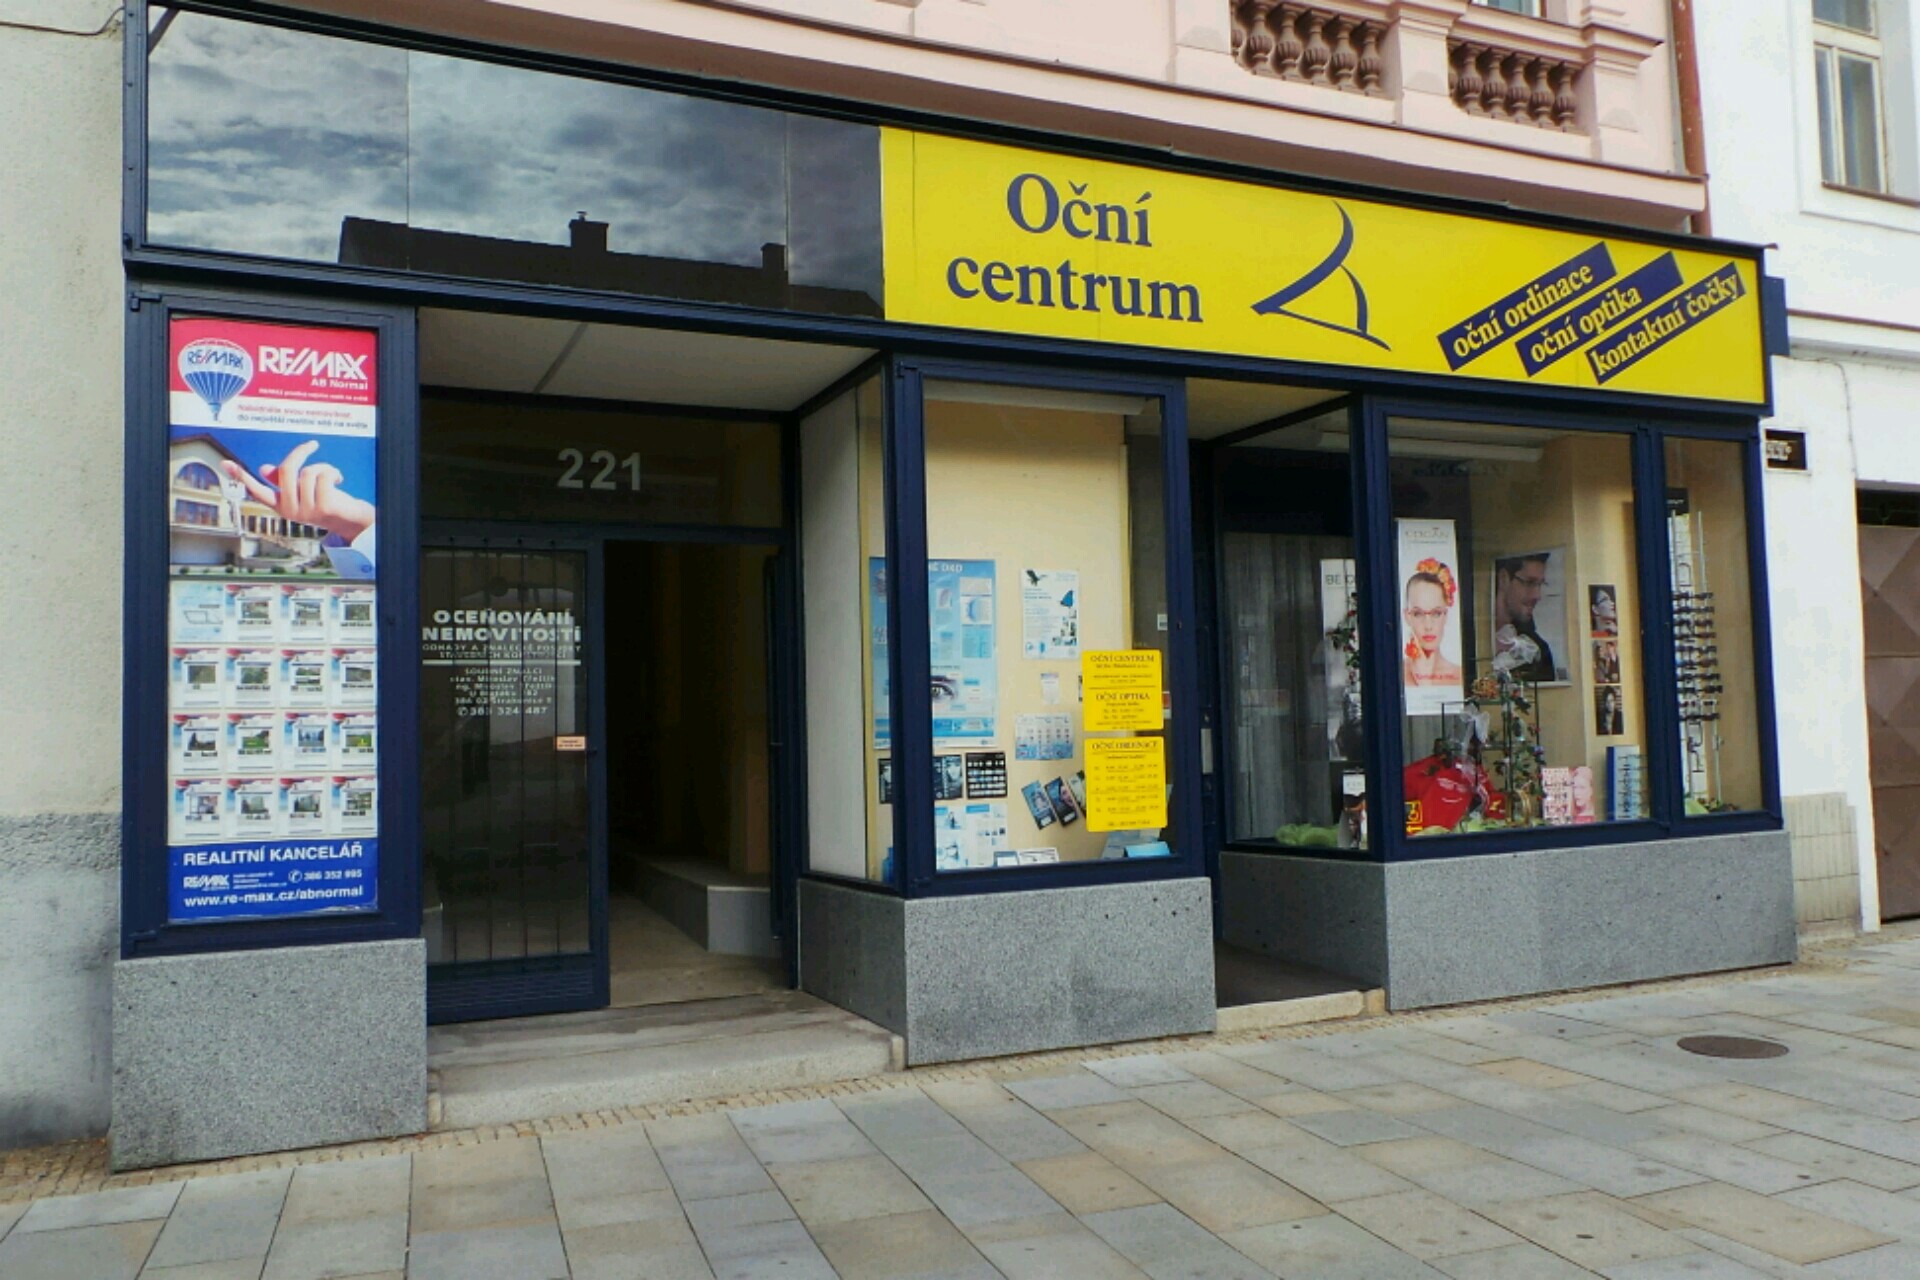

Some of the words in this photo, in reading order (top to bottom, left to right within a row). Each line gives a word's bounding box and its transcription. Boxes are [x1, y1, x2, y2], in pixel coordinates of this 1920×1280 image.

[1007, 173, 1152, 247] Oční
[947, 256, 1203, 323] centrum
[1453, 310, 1504, 357] oční
[1503, 264, 1594, 329] ordinace
[1530, 316, 1580, 363] oční
[1579, 286, 1642, 336] optika
[1590, 300, 1687, 377] kontaktní
[1686, 271, 1740, 318] čočky
[187, 348, 244, 370] RE/MAX
[258, 345, 368, 381] RE/MAX
[310, 377, 328, 388] AB
[329, 378, 368, 390] Normal
[557, 448, 641, 491] 221
[433, 608, 571, 625] OCEŇOVÁNÍ
[422, 625, 581, 642] NEMOVITOSTÍ
[498, 706, 520, 715] 324
[524, 706, 548, 715] 487
[183, 846, 265, 867] REALITNÍ
[270, 841, 363, 862] KANCELÁŘ
[183, 885, 363, 908] www.re-max.cz/abnormal
